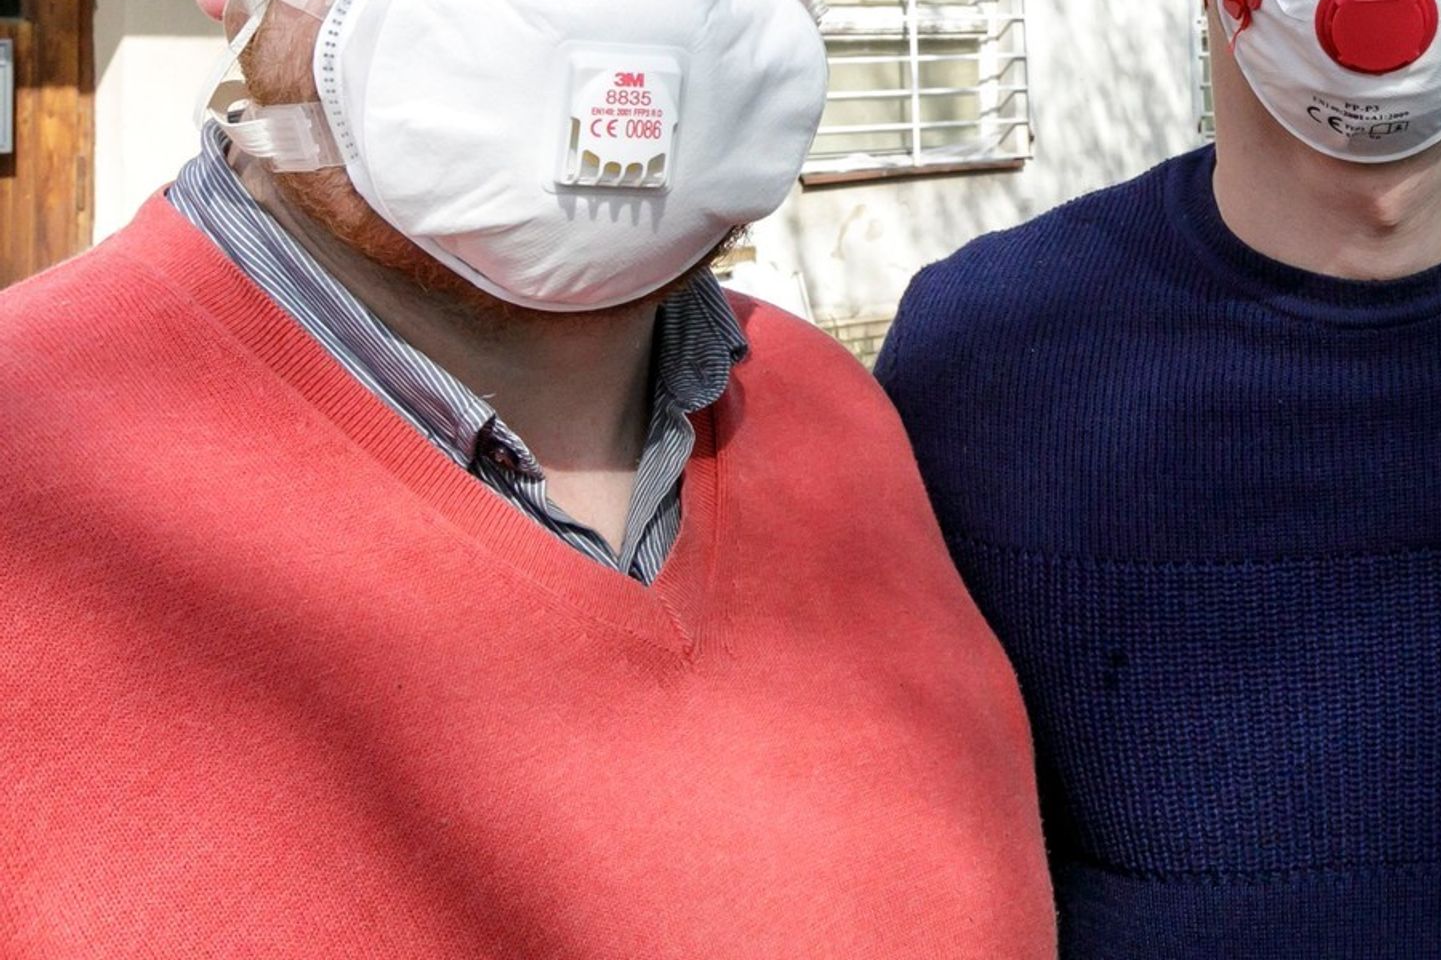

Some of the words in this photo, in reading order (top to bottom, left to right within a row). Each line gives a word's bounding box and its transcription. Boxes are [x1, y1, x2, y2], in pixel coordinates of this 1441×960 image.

[614, 72, 645, 88] 3M
[606, 89, 652, 106] 8835
[626, 119, 663, 140] 0086
